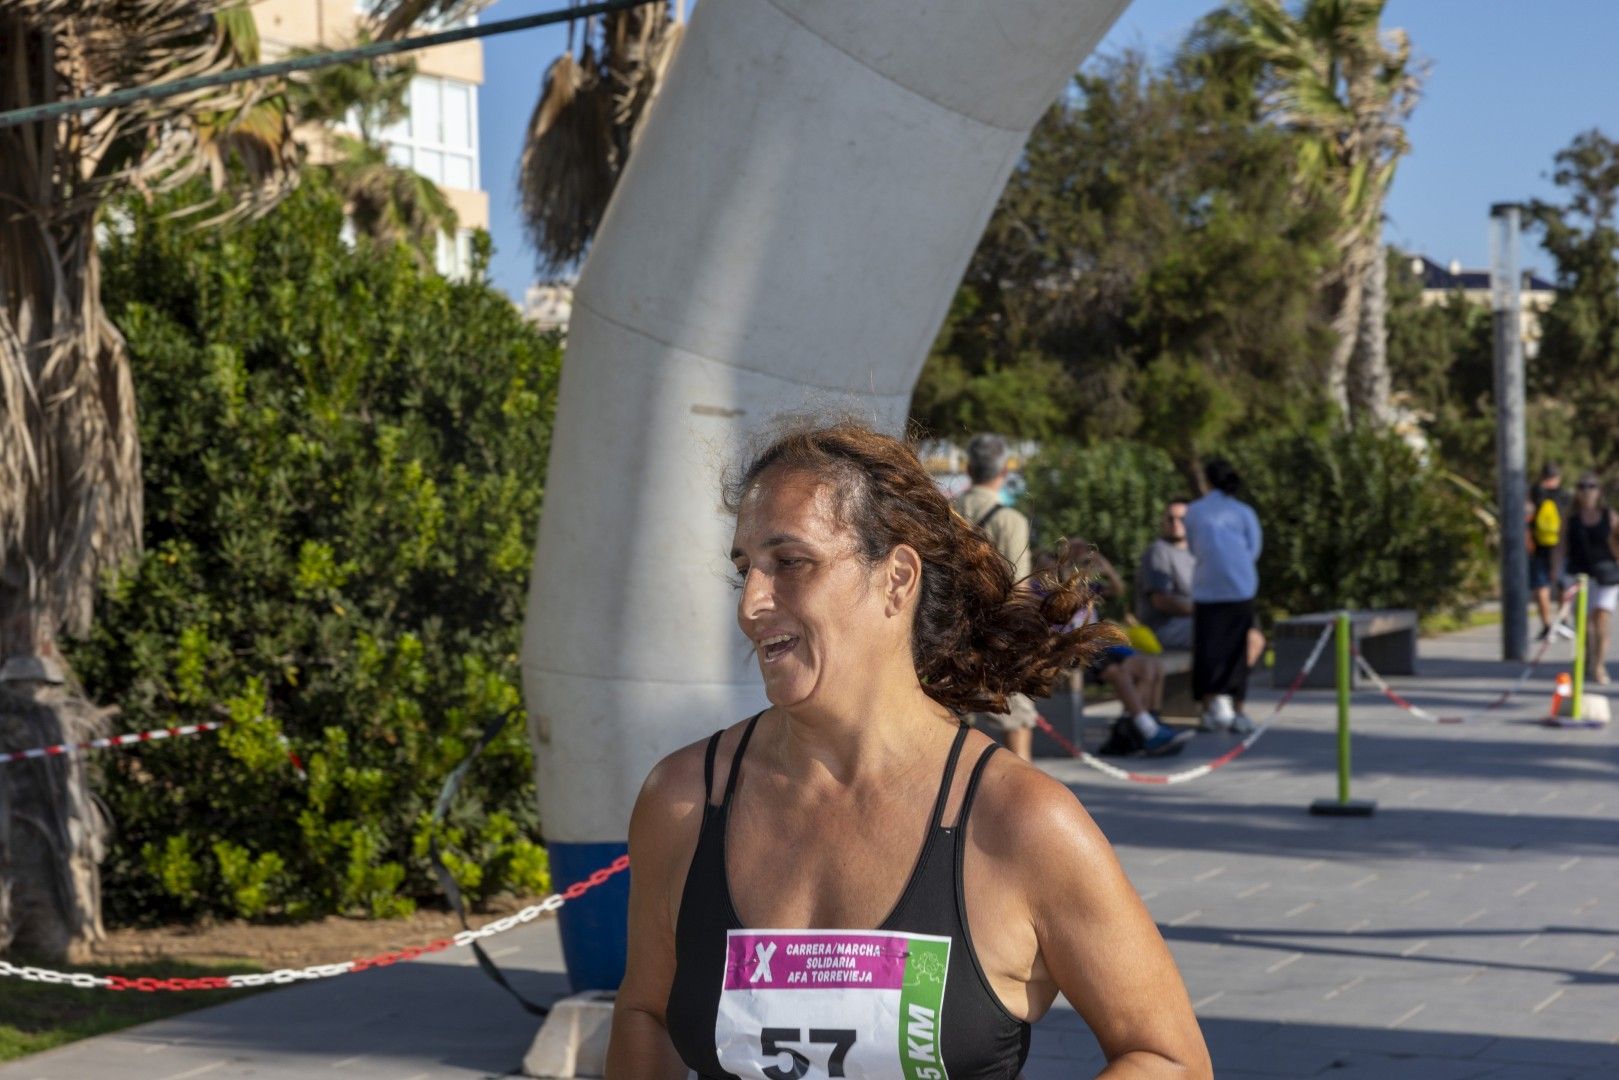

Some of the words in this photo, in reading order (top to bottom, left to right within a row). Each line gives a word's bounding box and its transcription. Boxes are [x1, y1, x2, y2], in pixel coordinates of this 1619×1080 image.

[786, 943, 880, 957] CARRERA/MARCHA
[750, 942, 776, 982] X
[806, 957, 856, 969] SOLIDARIA
[787, 971, 808, 983] AFA
[811, 970, 872, 983] TORREVIEJA
[760, 1028, 857, 1080] 57
